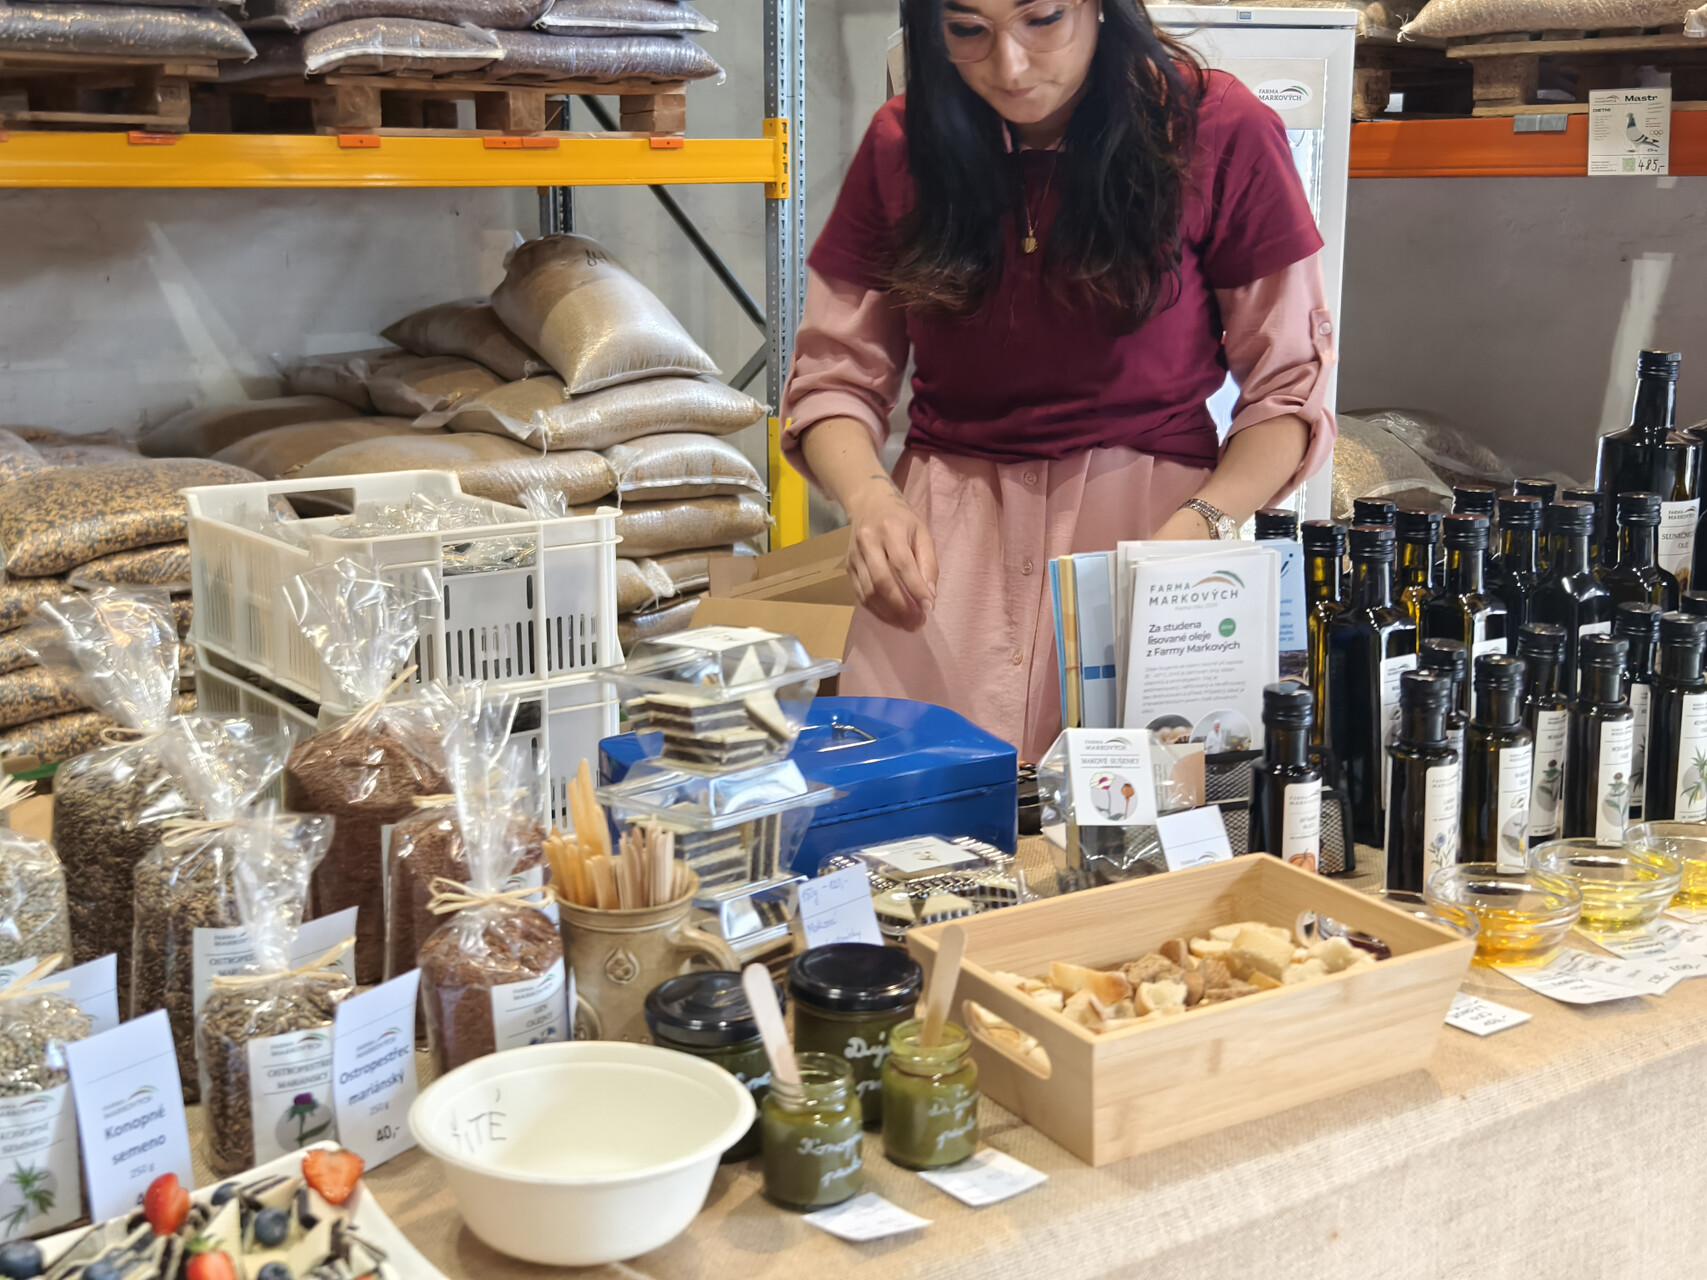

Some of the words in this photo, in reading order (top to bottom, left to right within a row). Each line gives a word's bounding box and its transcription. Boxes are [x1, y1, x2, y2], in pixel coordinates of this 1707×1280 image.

[1638, 159, 1665, 173] 485,-
[1150, 583, 1191, 593] FARMA
[1149, 589, 1239, 606] MARKOVÝCH
[1148, 624, 1161, 633] Za
[1163, 621, 1202, 633] studena
[1147, 633, 1187, 645] lisované
[1188, 631, 1212, 643] oleje
[1154, 646, 1185, 657] Farmy
[1187, 641, 1241, 654] Markových
[339, 1043, 410, 1085] Ostropestřec
[348, 1068, 405, 1106] mariánský
[104, 1104, 166, 1141] Konopné
[112, 1134, 166, 1166] semeno
